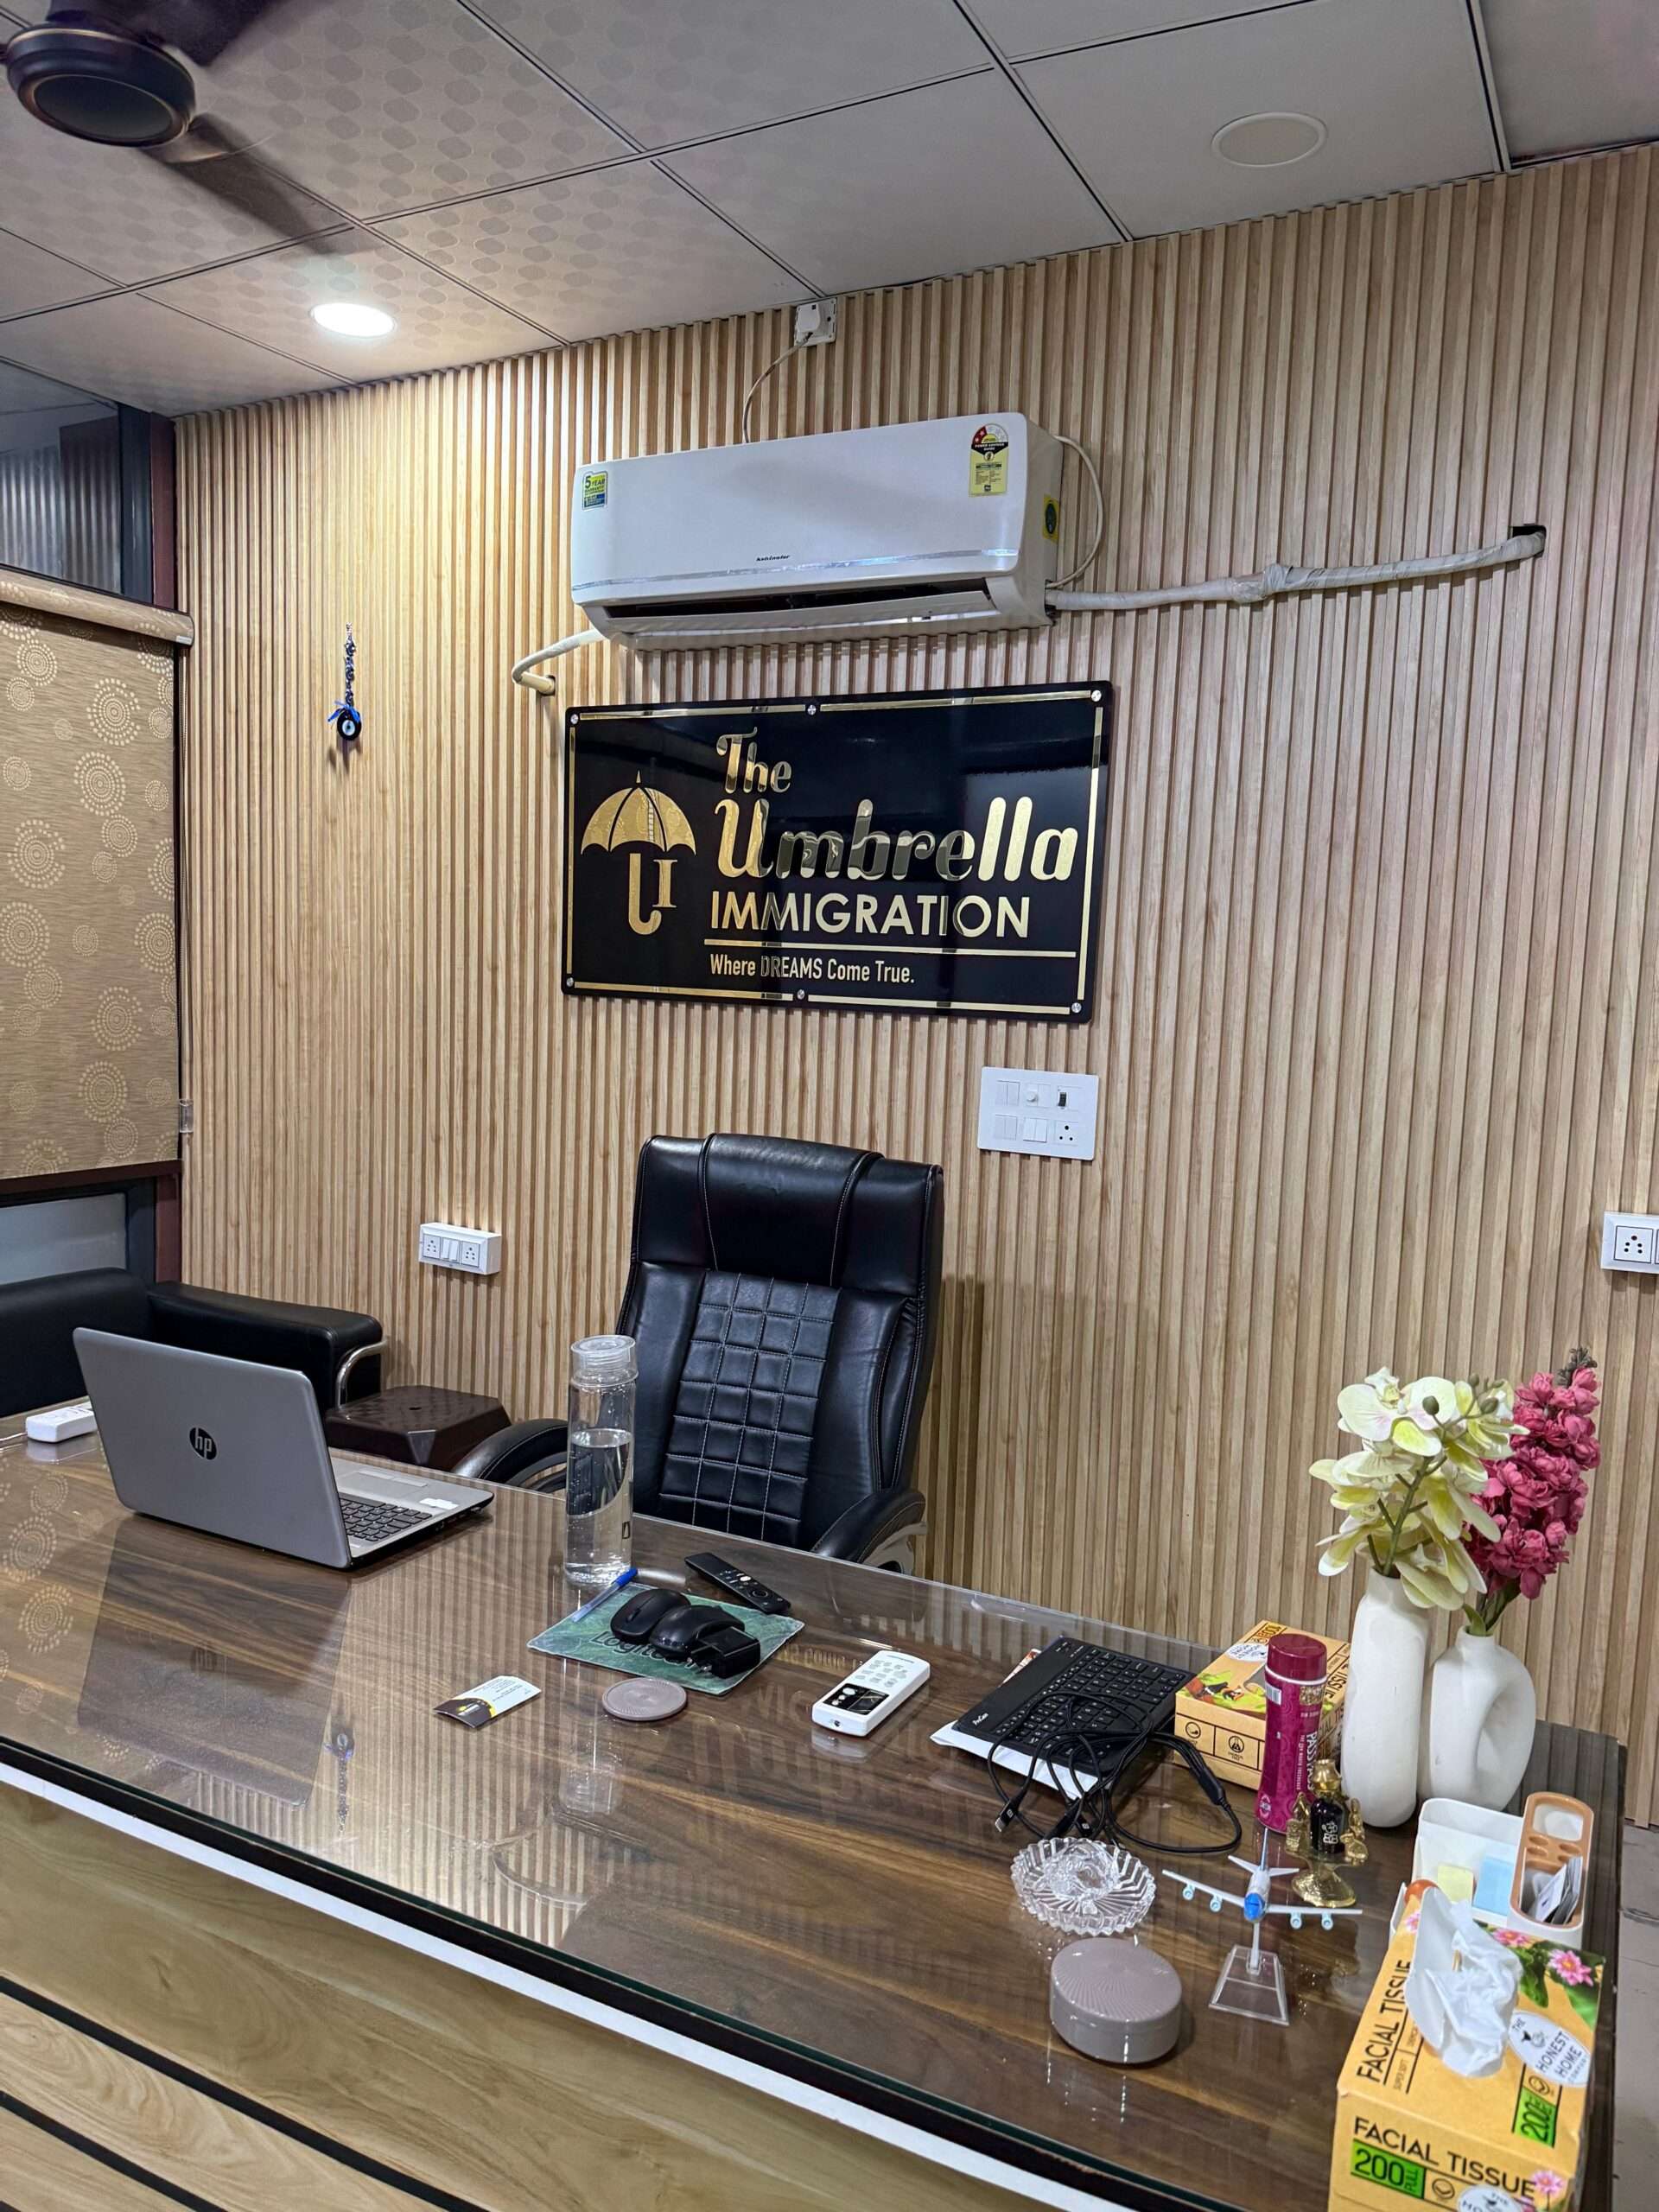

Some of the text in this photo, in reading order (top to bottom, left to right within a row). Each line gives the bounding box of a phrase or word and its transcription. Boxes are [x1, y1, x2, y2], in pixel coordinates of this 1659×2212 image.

[585, 475, 591, 488] 5
[716, 727, 791, 793] The
[715, 797, 1079, 882] Umbrella
[711, 892, 1030, 939] IMMIGRATION
[710, 954, 915, 985] Where DREAMS Come True.
[194, 1427, 214, 1459] hp
[1511, 2018, 1526, 2031] THE
[1357, 2021, 1400, 2083] FACIAL
[1535, 2029, 1570, 2073] HONEST
[1554, 2045, 1583, 2078] HOME
[1353, 2116, 1537, 2202] FACIAL TISSUE
[1354, 2148, 1405, 2185] 200
